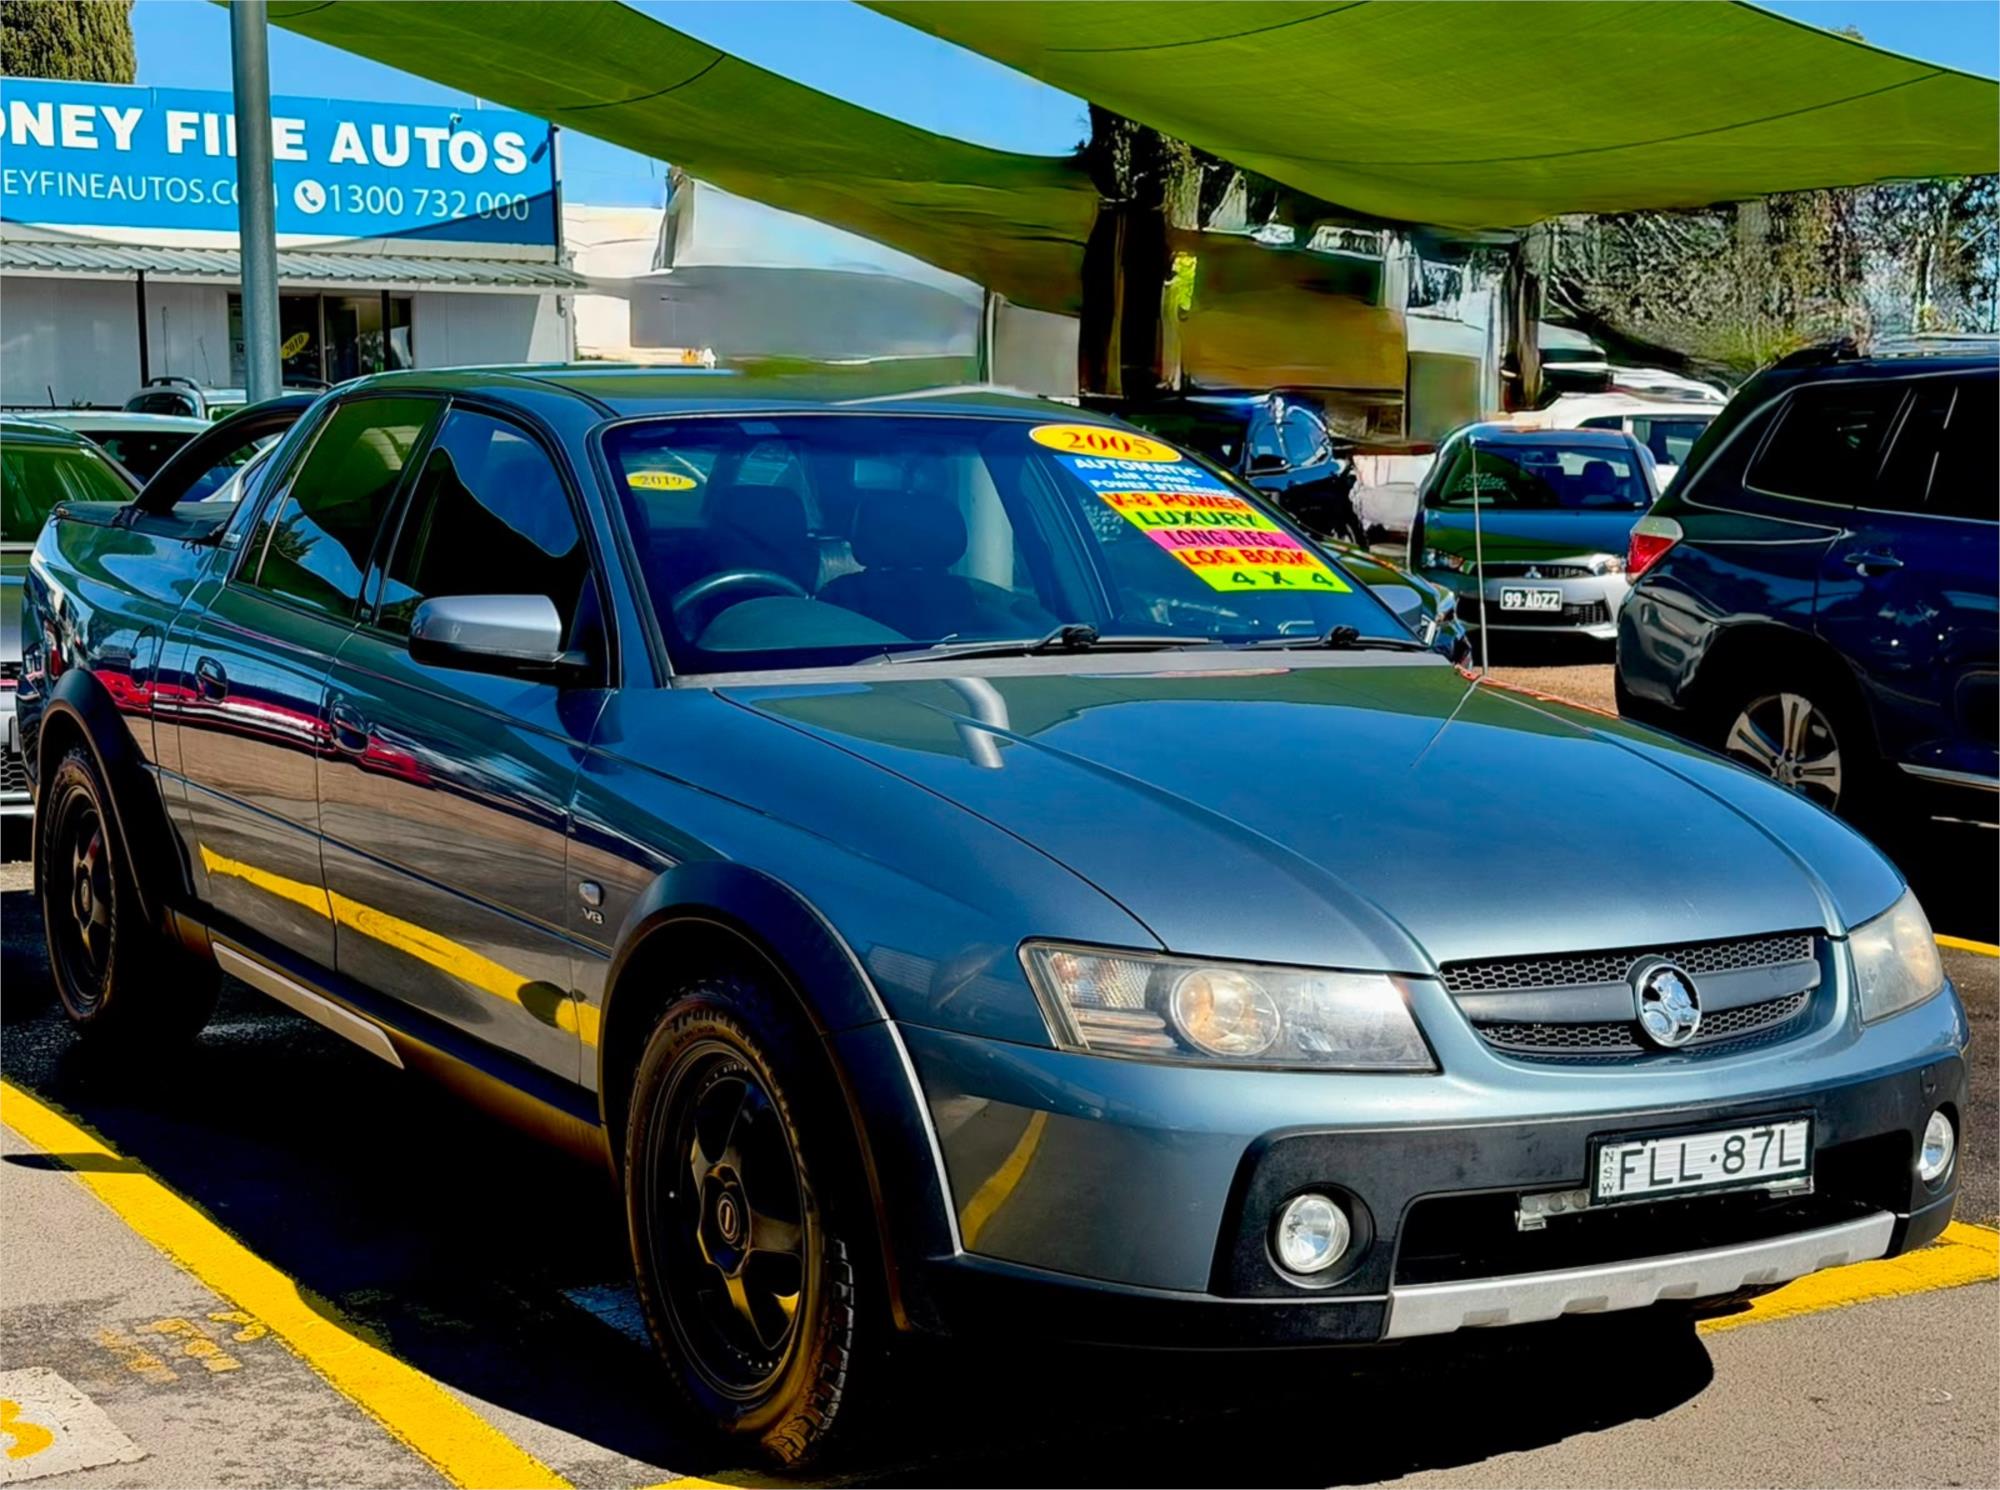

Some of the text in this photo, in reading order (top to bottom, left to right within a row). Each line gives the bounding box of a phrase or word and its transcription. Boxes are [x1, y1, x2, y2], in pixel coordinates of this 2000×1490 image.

[0, 100, 529, 175] NEY FIE AUTOS
[3, 168, 529, 221] EYFINEAUTOS.C 1300 732 000
[1062, 431, 1153, 455] 2005
[1074, 458, 1203, 478] AUTOMATIC
[1112, 471, 1143, 480] AIR
[1089, 480, 1152, 490] POWER
[1104, 493, 1247, 510] V-8 POWER
[1136, 511, 1259, 526] LUXURY
[1164, 530, 1226, 546] LONG
[1180, 550, 1318, 567] LOG BOOK
[1232, 571, 1334, 586] 4 X 4
[1601, 1151, 1615, 1194] NSW
